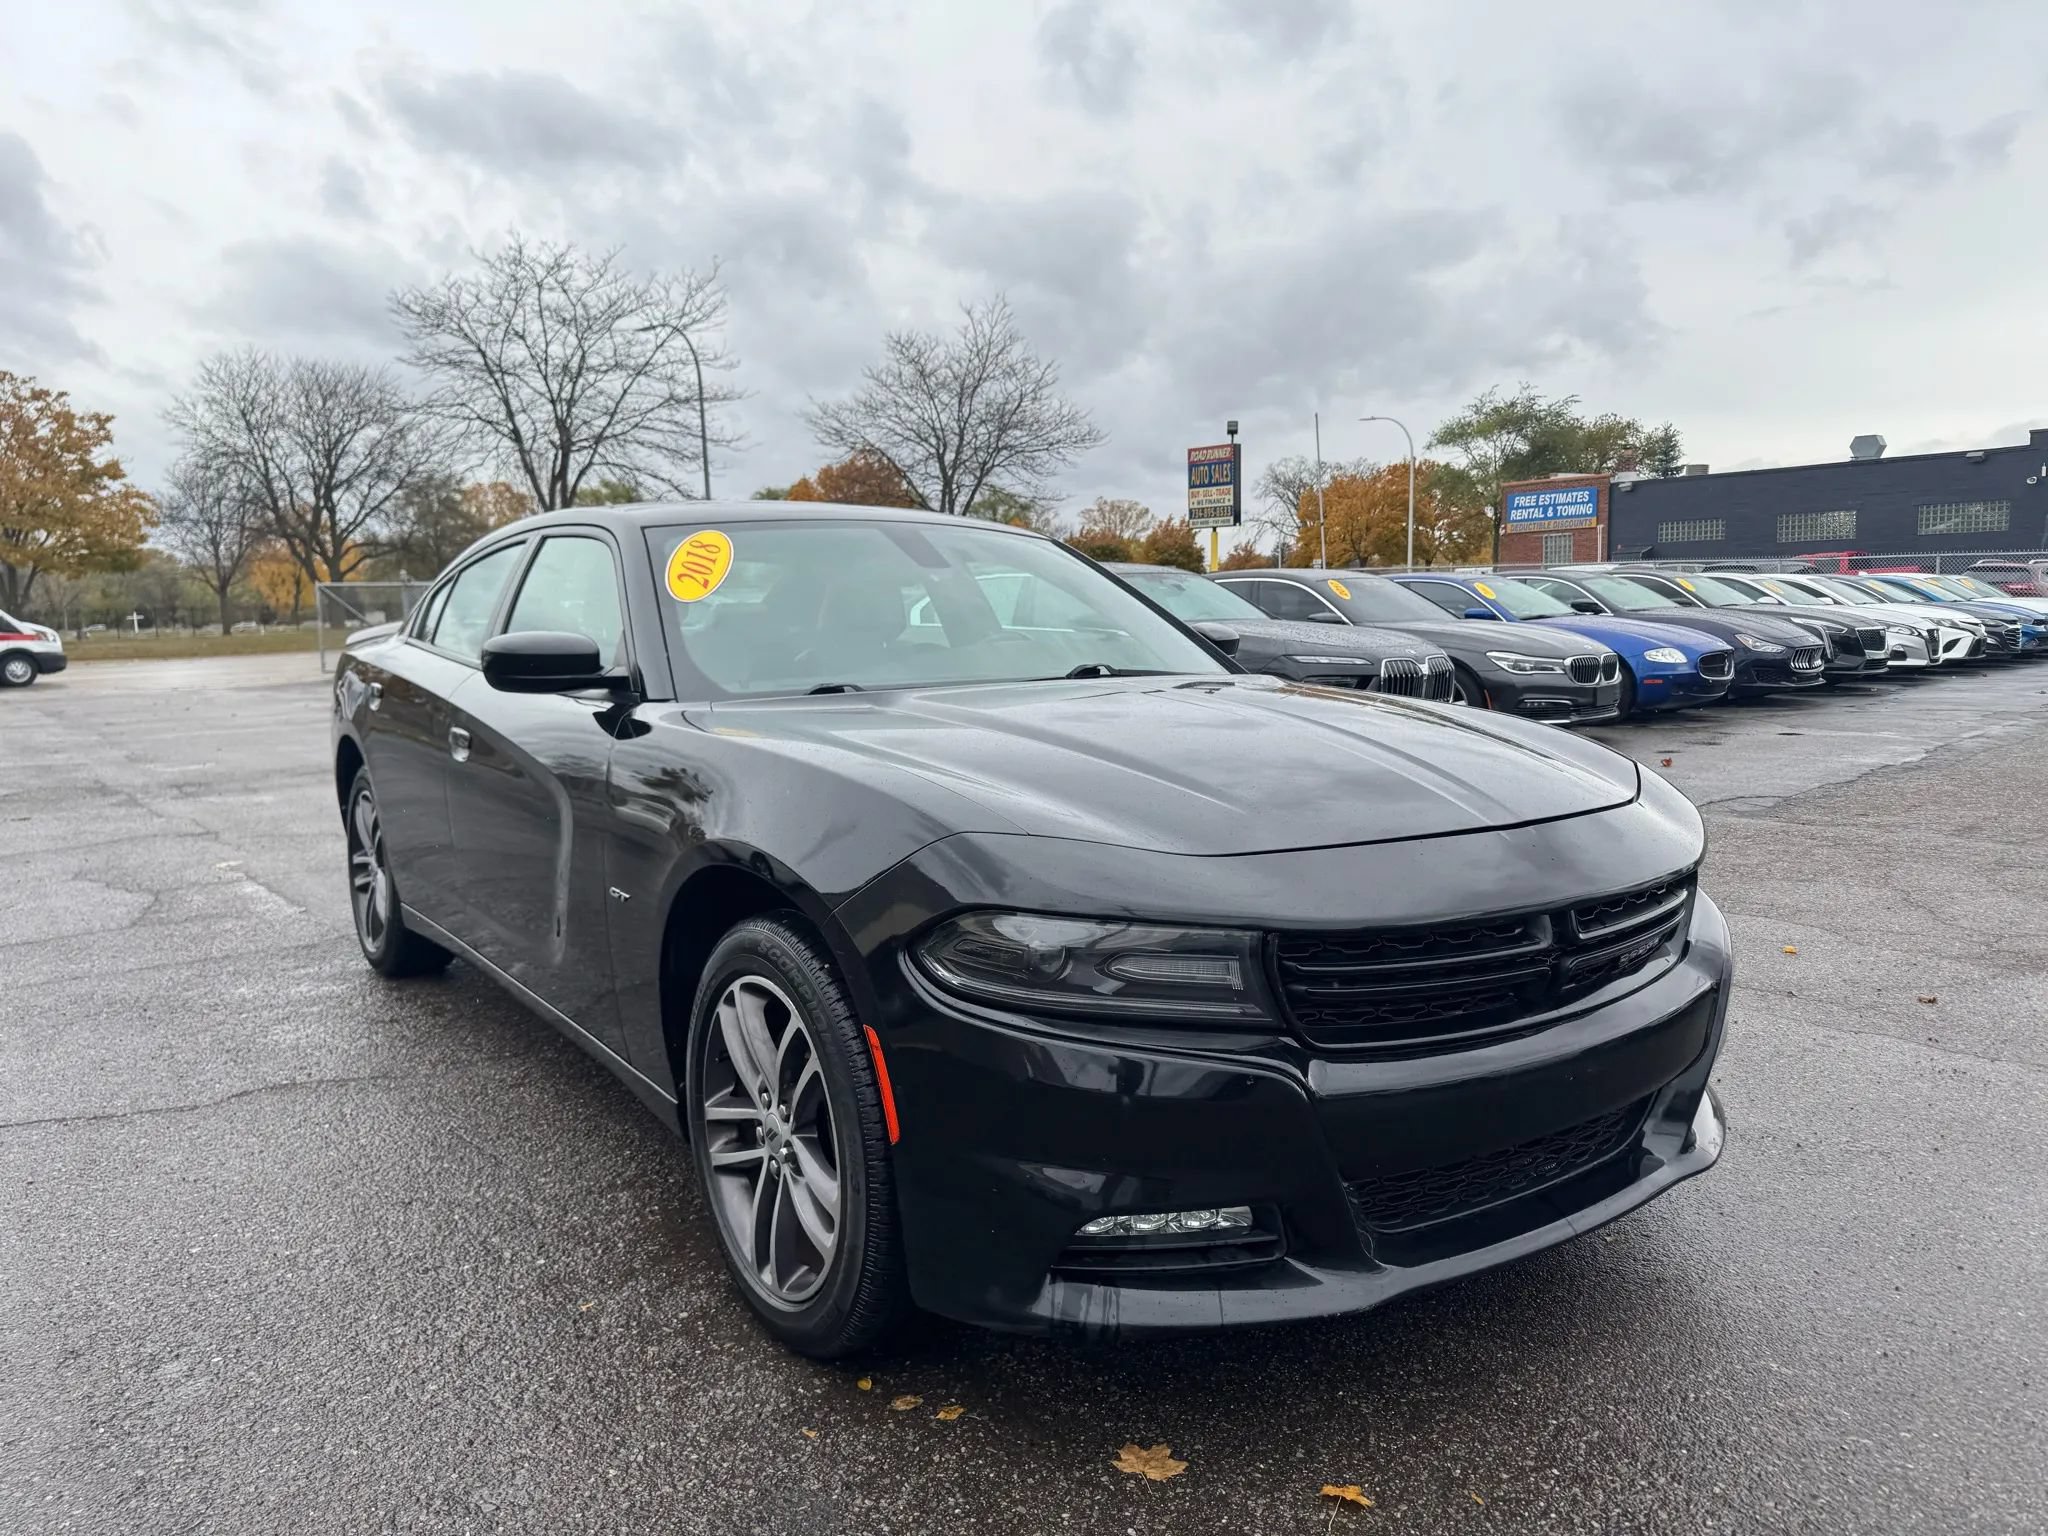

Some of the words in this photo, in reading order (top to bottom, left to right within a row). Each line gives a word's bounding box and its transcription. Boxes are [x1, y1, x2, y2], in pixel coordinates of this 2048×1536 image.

[1191, 466, 1209, 485] AUTO
[1211, 463, 1231, 484] SALES
[1205, 497, 1226, 505] FINANCE
[1514, 494, 1537, 507] FREE
[1538, 491, 1589, 505] ESTIMATES
[1510, 507, 1544, 520] RENTAL
[1547, 507, 1553, 517] &
[1557, 503, 1593, 516] TOWING
[1511, 521, 1552, 532] DEDUCTIBLE
[1553, 518, 1593, 529] DISCOUNTS
[677, 539, 721, 590] 2018
